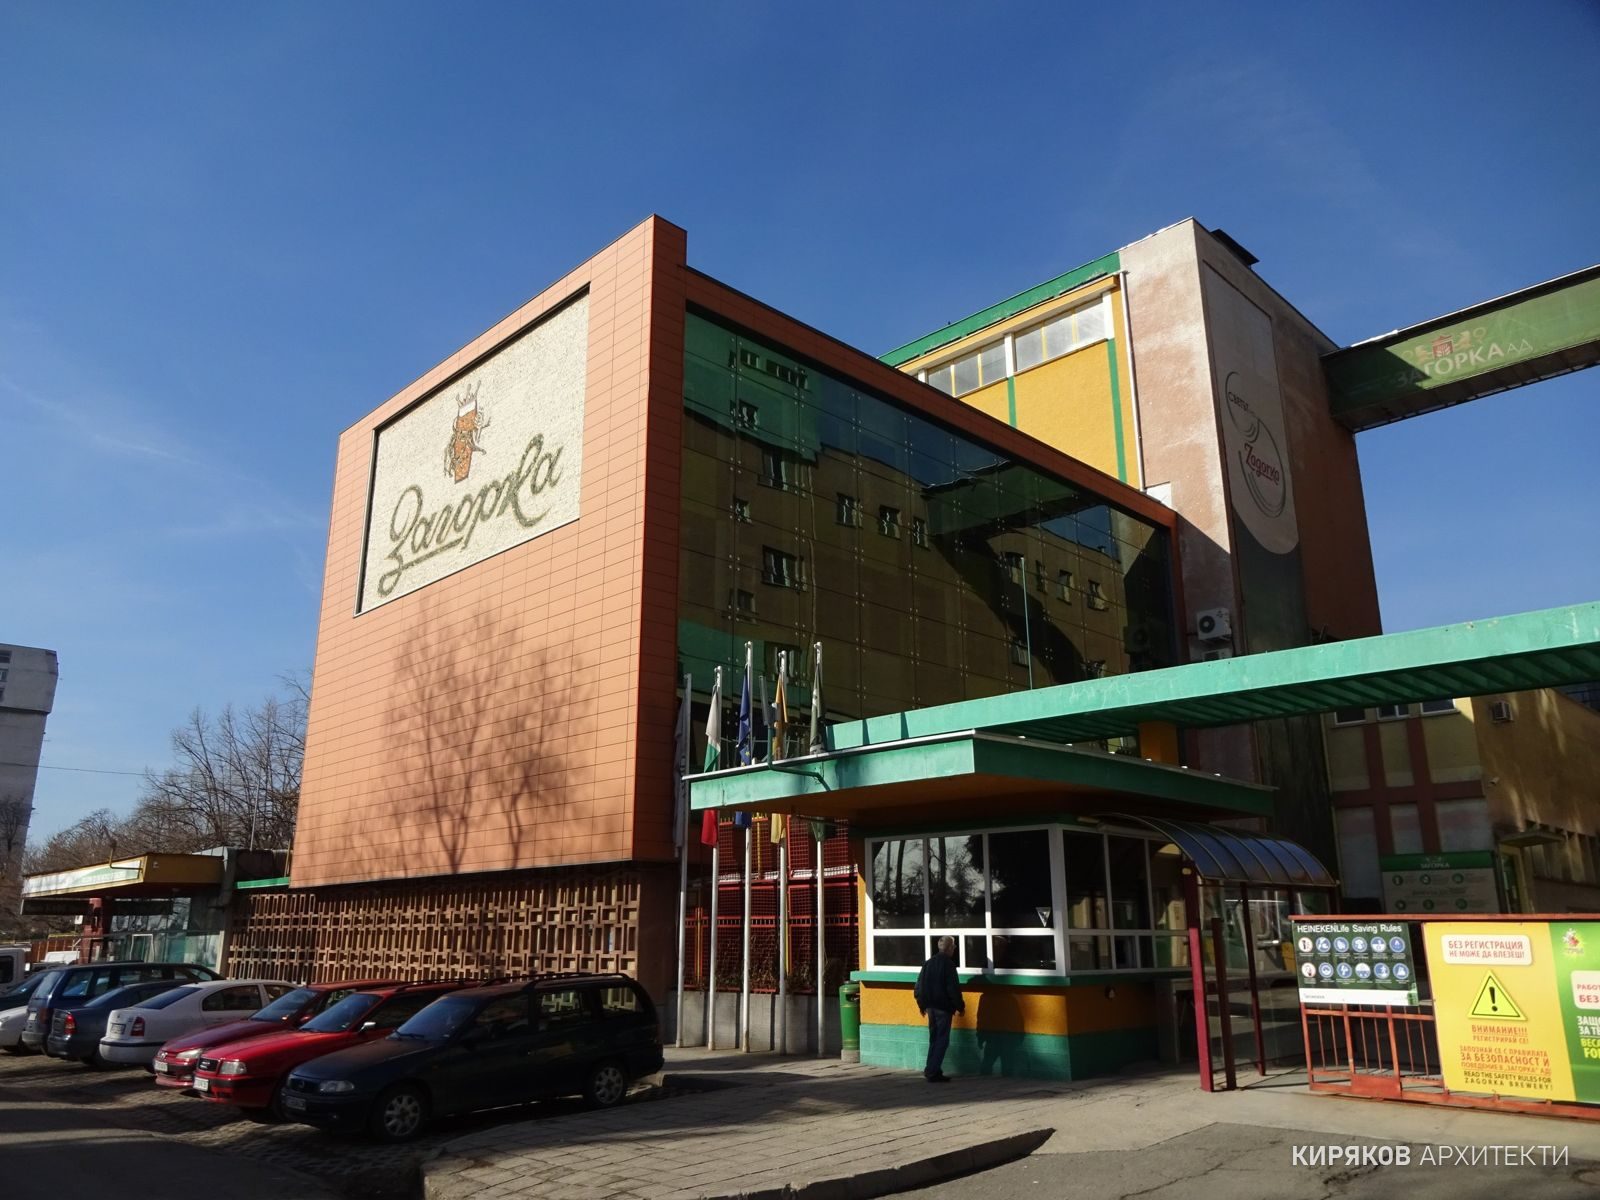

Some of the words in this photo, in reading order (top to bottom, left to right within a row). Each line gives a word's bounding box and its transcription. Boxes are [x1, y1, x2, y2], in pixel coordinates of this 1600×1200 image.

[1352, 924, 1378, 934] Saving
[1380, 924, 1402, 933] Rules
[1448, 940, 1463, 949] БЕЗ
[1465, 940, 1523, 950] РЕГИСТРАЦИЯ
[1459, 950, 1480, 958] МОЖЕ
[1481, 951, 1492, 959] ДА
[1579, 995, 1599, 1003] БЕЗ
[1471, 1024, 1528, 1035] ВНИМАНИЕ!!!
[1578, 1026, 1590, 1036] ЗА
[1461, 1052, 1472, 1061] ЗА
[1474, 1053, 1540, 1066] БЕЗОПАСНОСТ
[1543, 1058, 1550, 1066] И
[1481, 1071, 1494, 1079] THE
[1494, 1072, 1517, 1080] SAFETY
[1518, 1074, 1538, 1082] RULES
[1538, 1075, 1552, 1083] FOR
